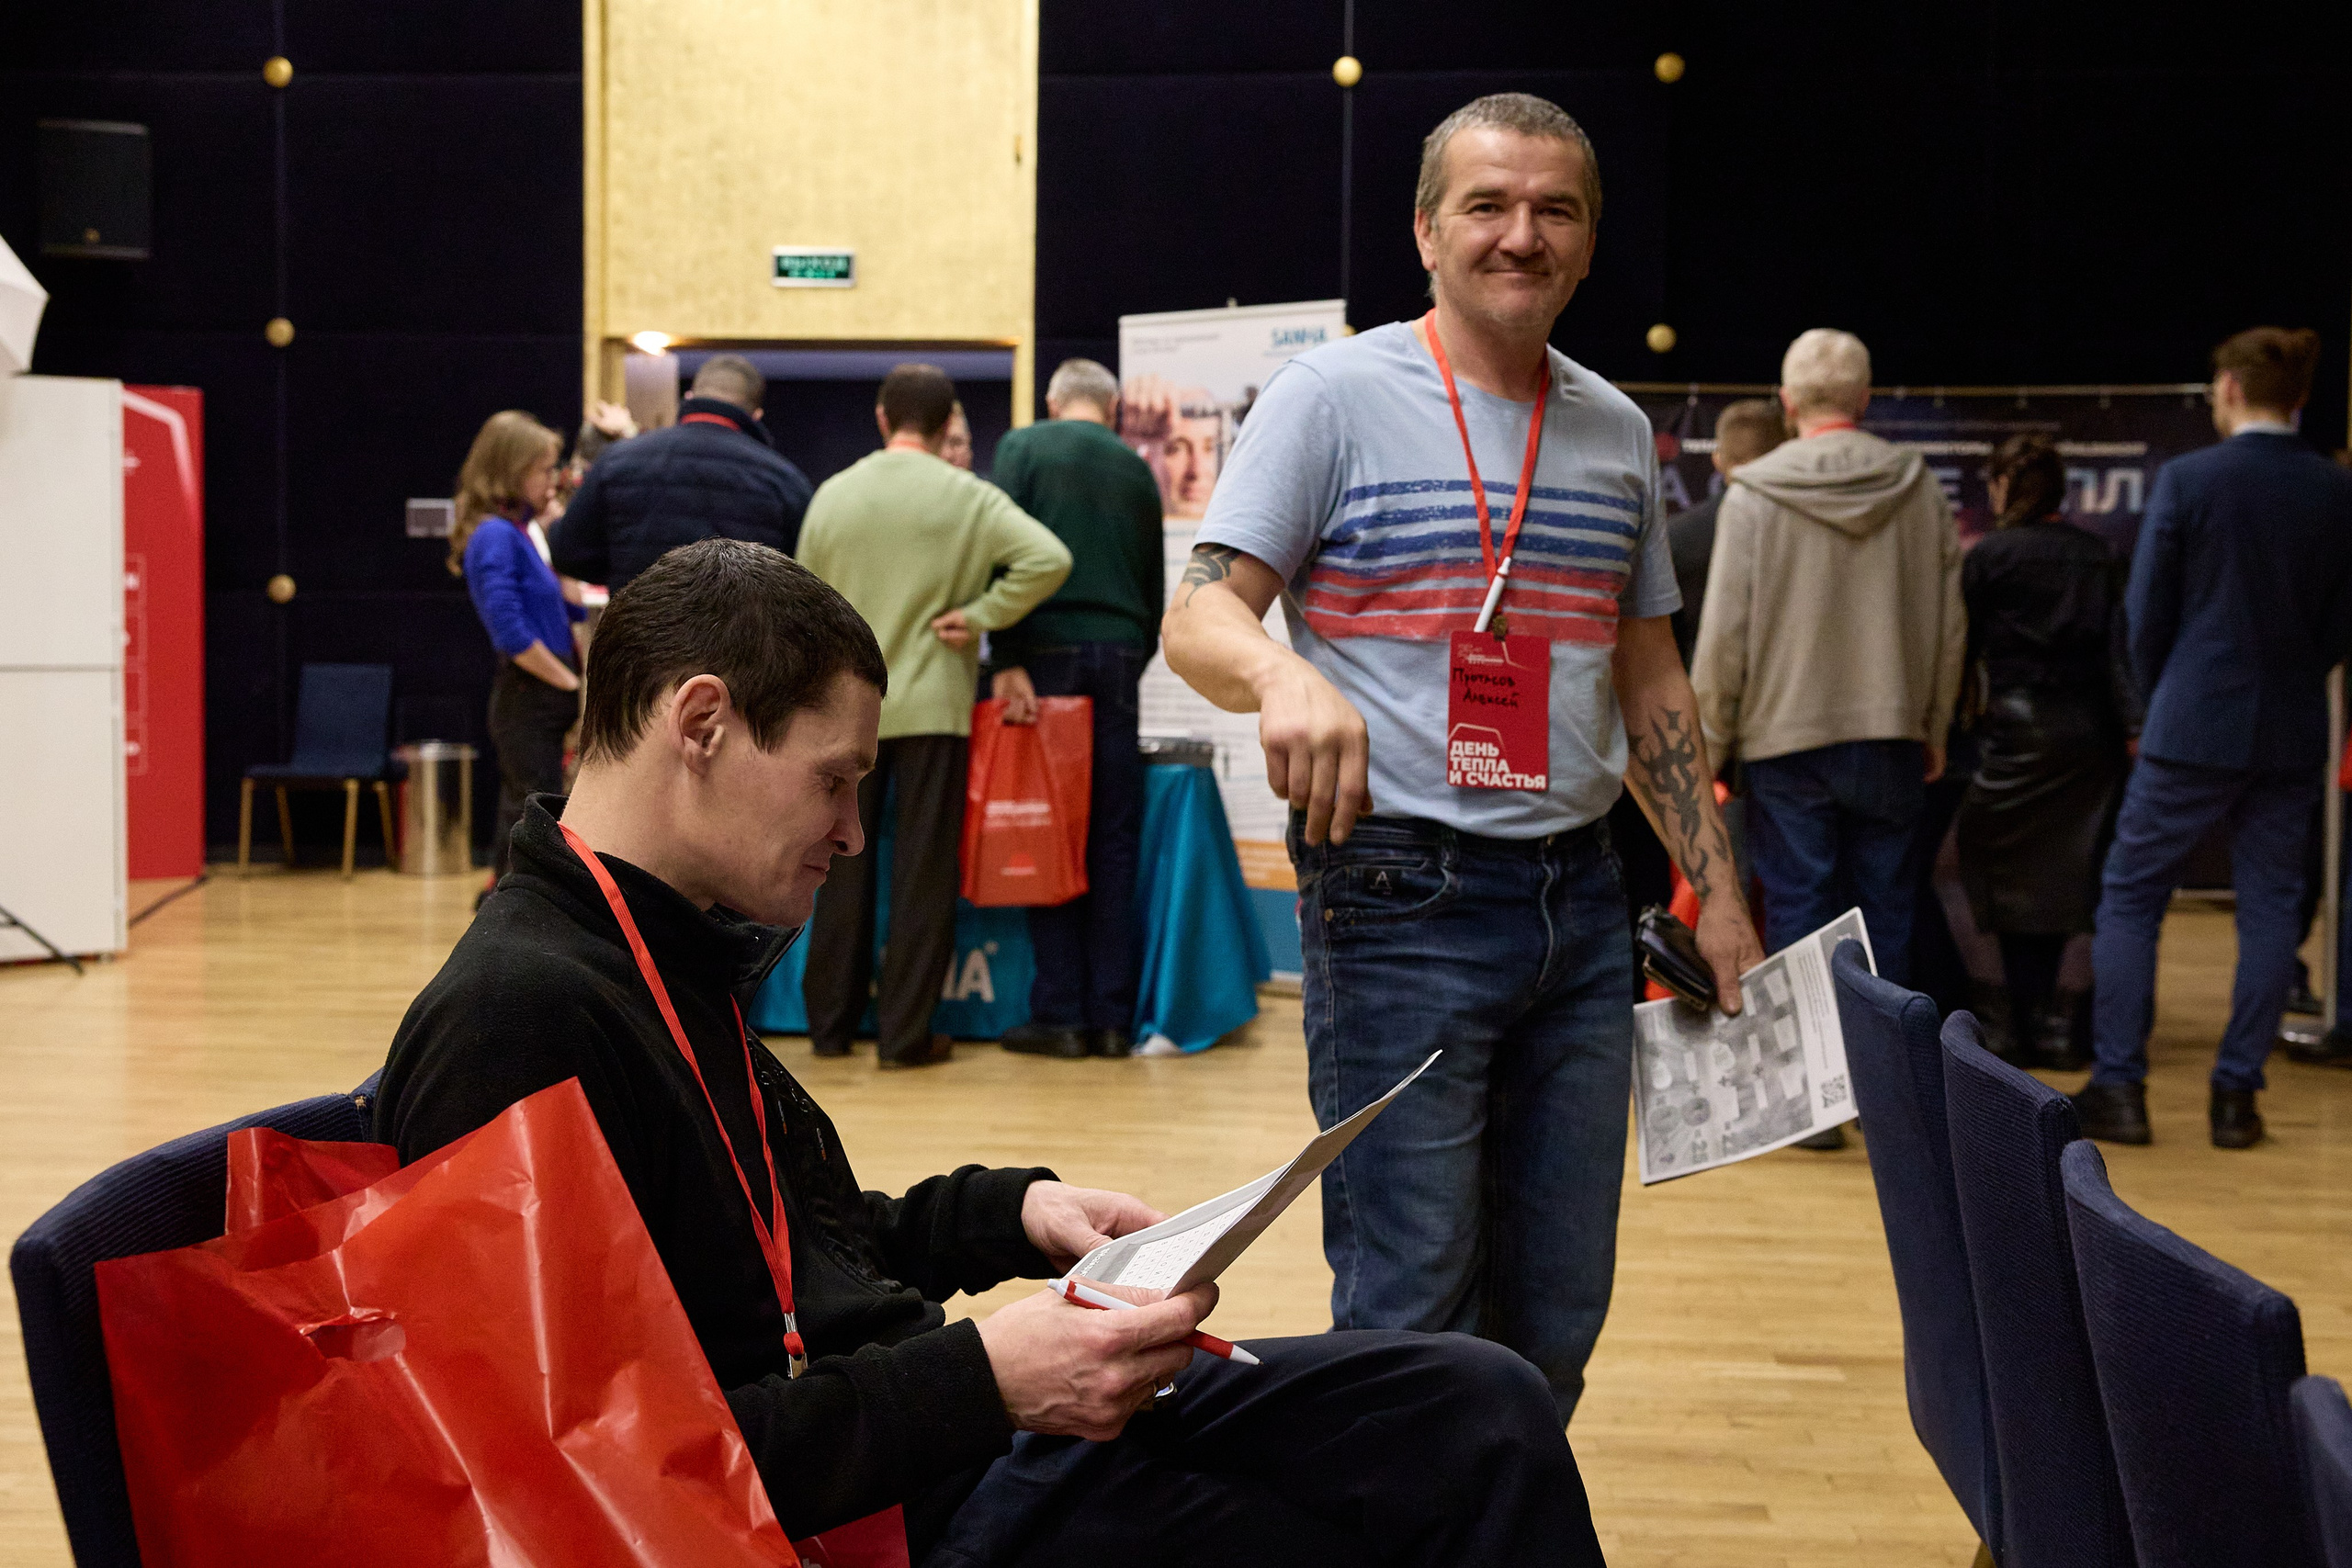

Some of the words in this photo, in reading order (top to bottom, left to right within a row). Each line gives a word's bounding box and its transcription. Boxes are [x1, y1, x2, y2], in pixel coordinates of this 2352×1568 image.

[1451, 740, 1499, 757] ДЕНЬ
[1451, 757, 1510, 773] ТЕПЛА
[1449, 771, 1462, 785] И
[1465, 772, 1546, 789] СЧАСТЬЯ
